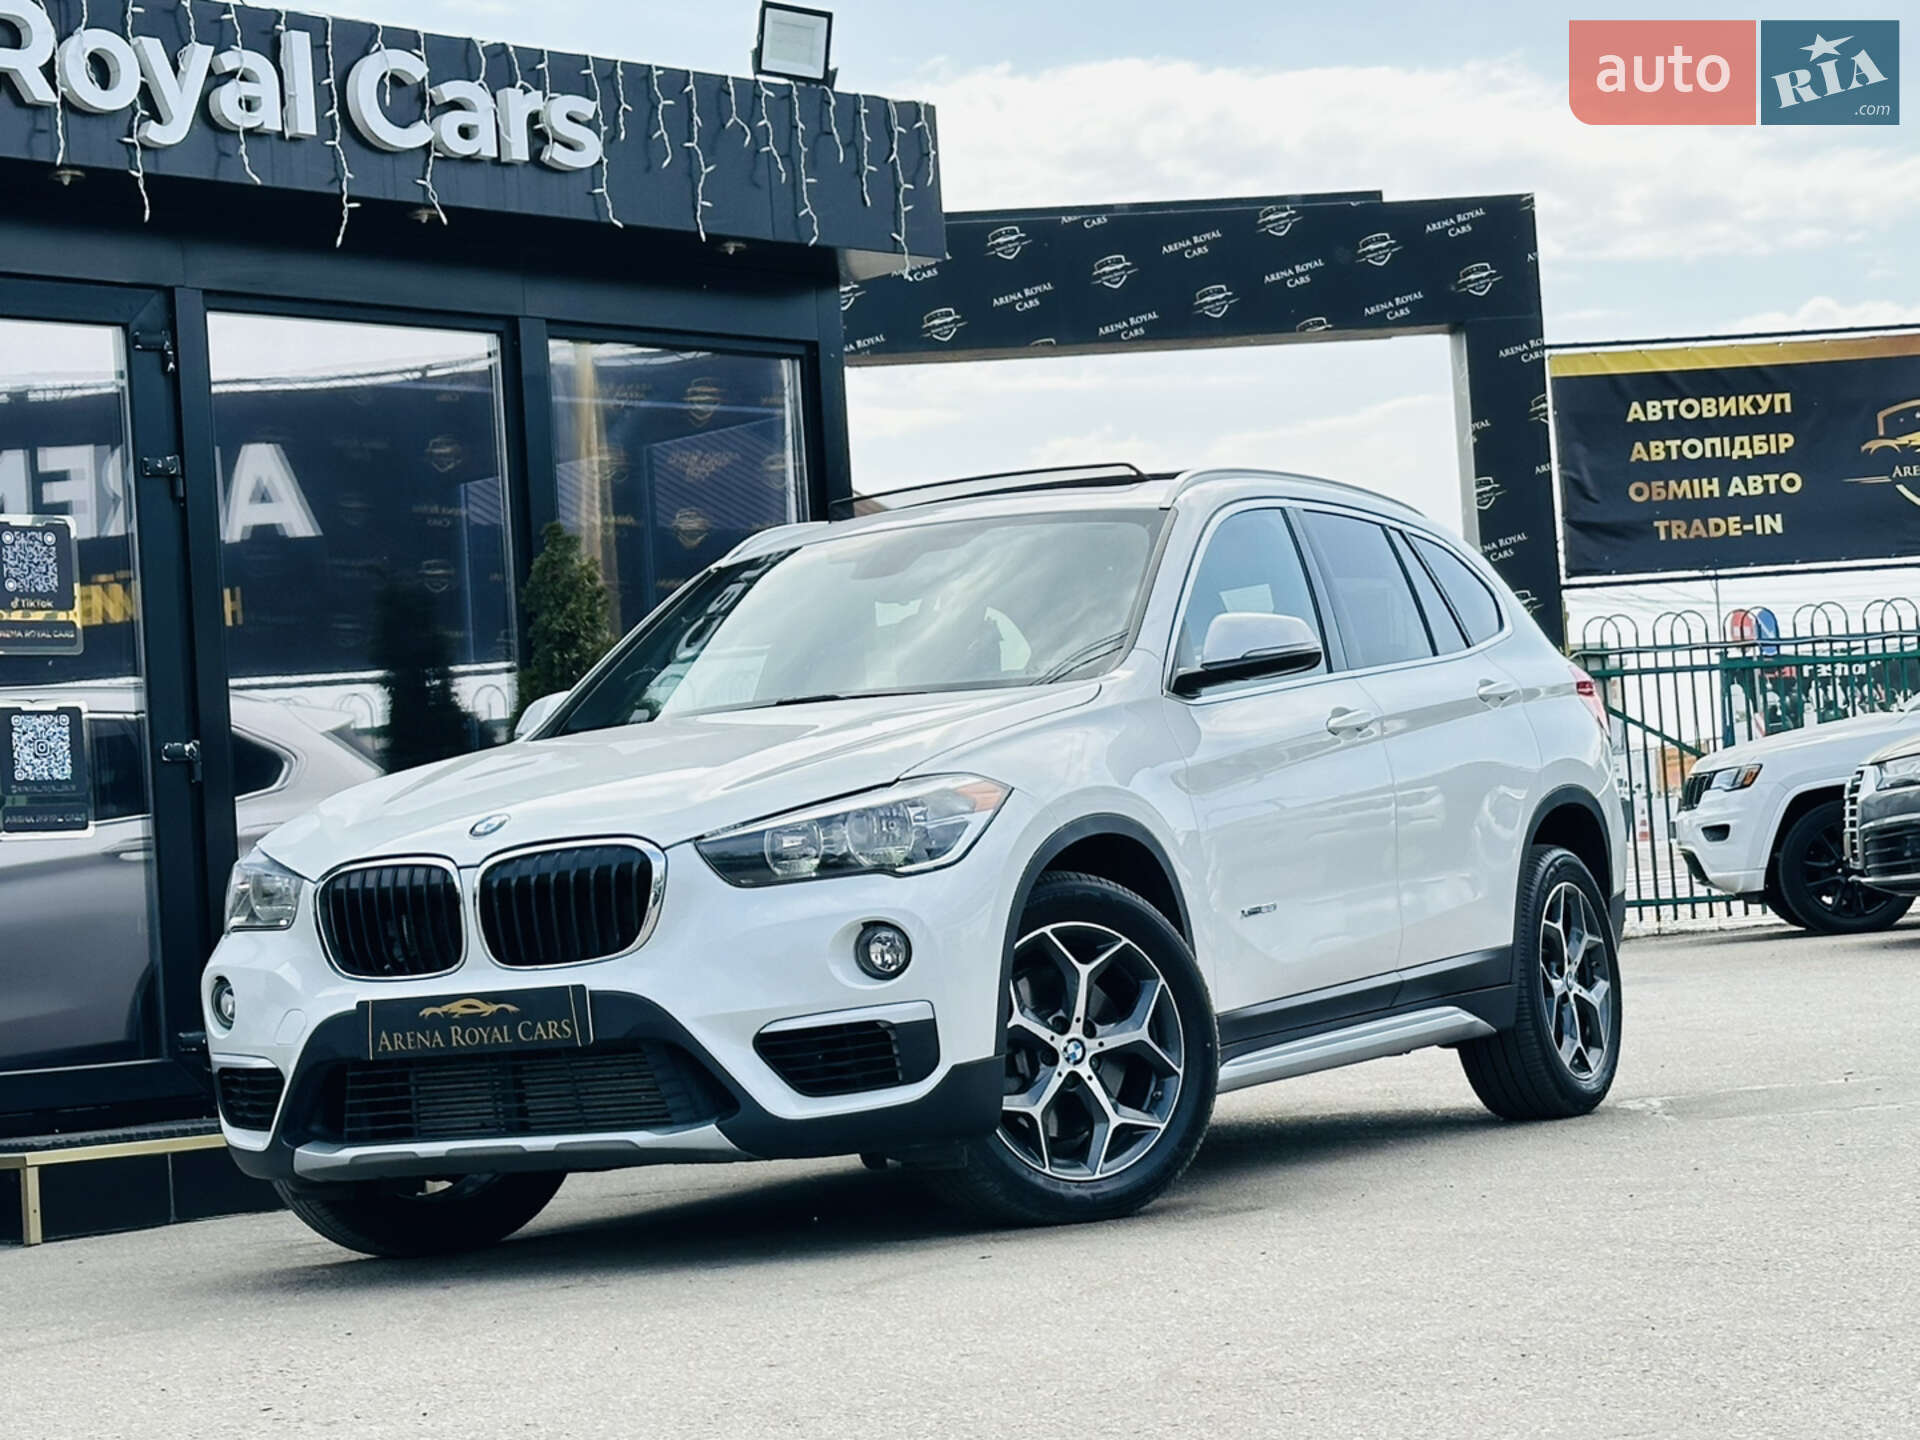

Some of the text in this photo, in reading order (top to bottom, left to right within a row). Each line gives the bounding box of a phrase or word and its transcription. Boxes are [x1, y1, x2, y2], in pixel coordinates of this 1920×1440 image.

[0, 0, 601, 171] Royal Cars
[1425, 207, 1486, 234] ARENA ROYAL
[1448, 223, 1472, 237] CARS
[1162, 229, 1222, 255] ARENA ROYAL
[1184, 245, 1208, 259] CARS
[1264, 258, 1325, 284] ARENA ROYAL
[1287, 274, 1311, 288] CARS
[993, 282, 1054, 307] ARENA ROYAL
[1015, 298, 1040, 312] CARS
[1364, 291, 1424, 317] ARENA ROYAL
[1098, 311, 1159, 336] ARENA ROYAL
[1386, 306, 1410, 320] CARS
[1121, 327, 1145, 340] CARS
[1499, 343, 1528, 358] ARENA
[1626, 392, 1792, 422] АВТОВИКУП
[1629, 433, 1795, 462] АВТОПІДБІР
[1628, 472, 1802, 503] ОБМІН АВТО
[1498, 531, 1528, 547] ROYAL
[1654, 513, 1784, 540] TRADE-IN
[1490, 548, 1514, 561] CARS
[378, 1018, 572, 1052] ARENA ROYAL CARS
